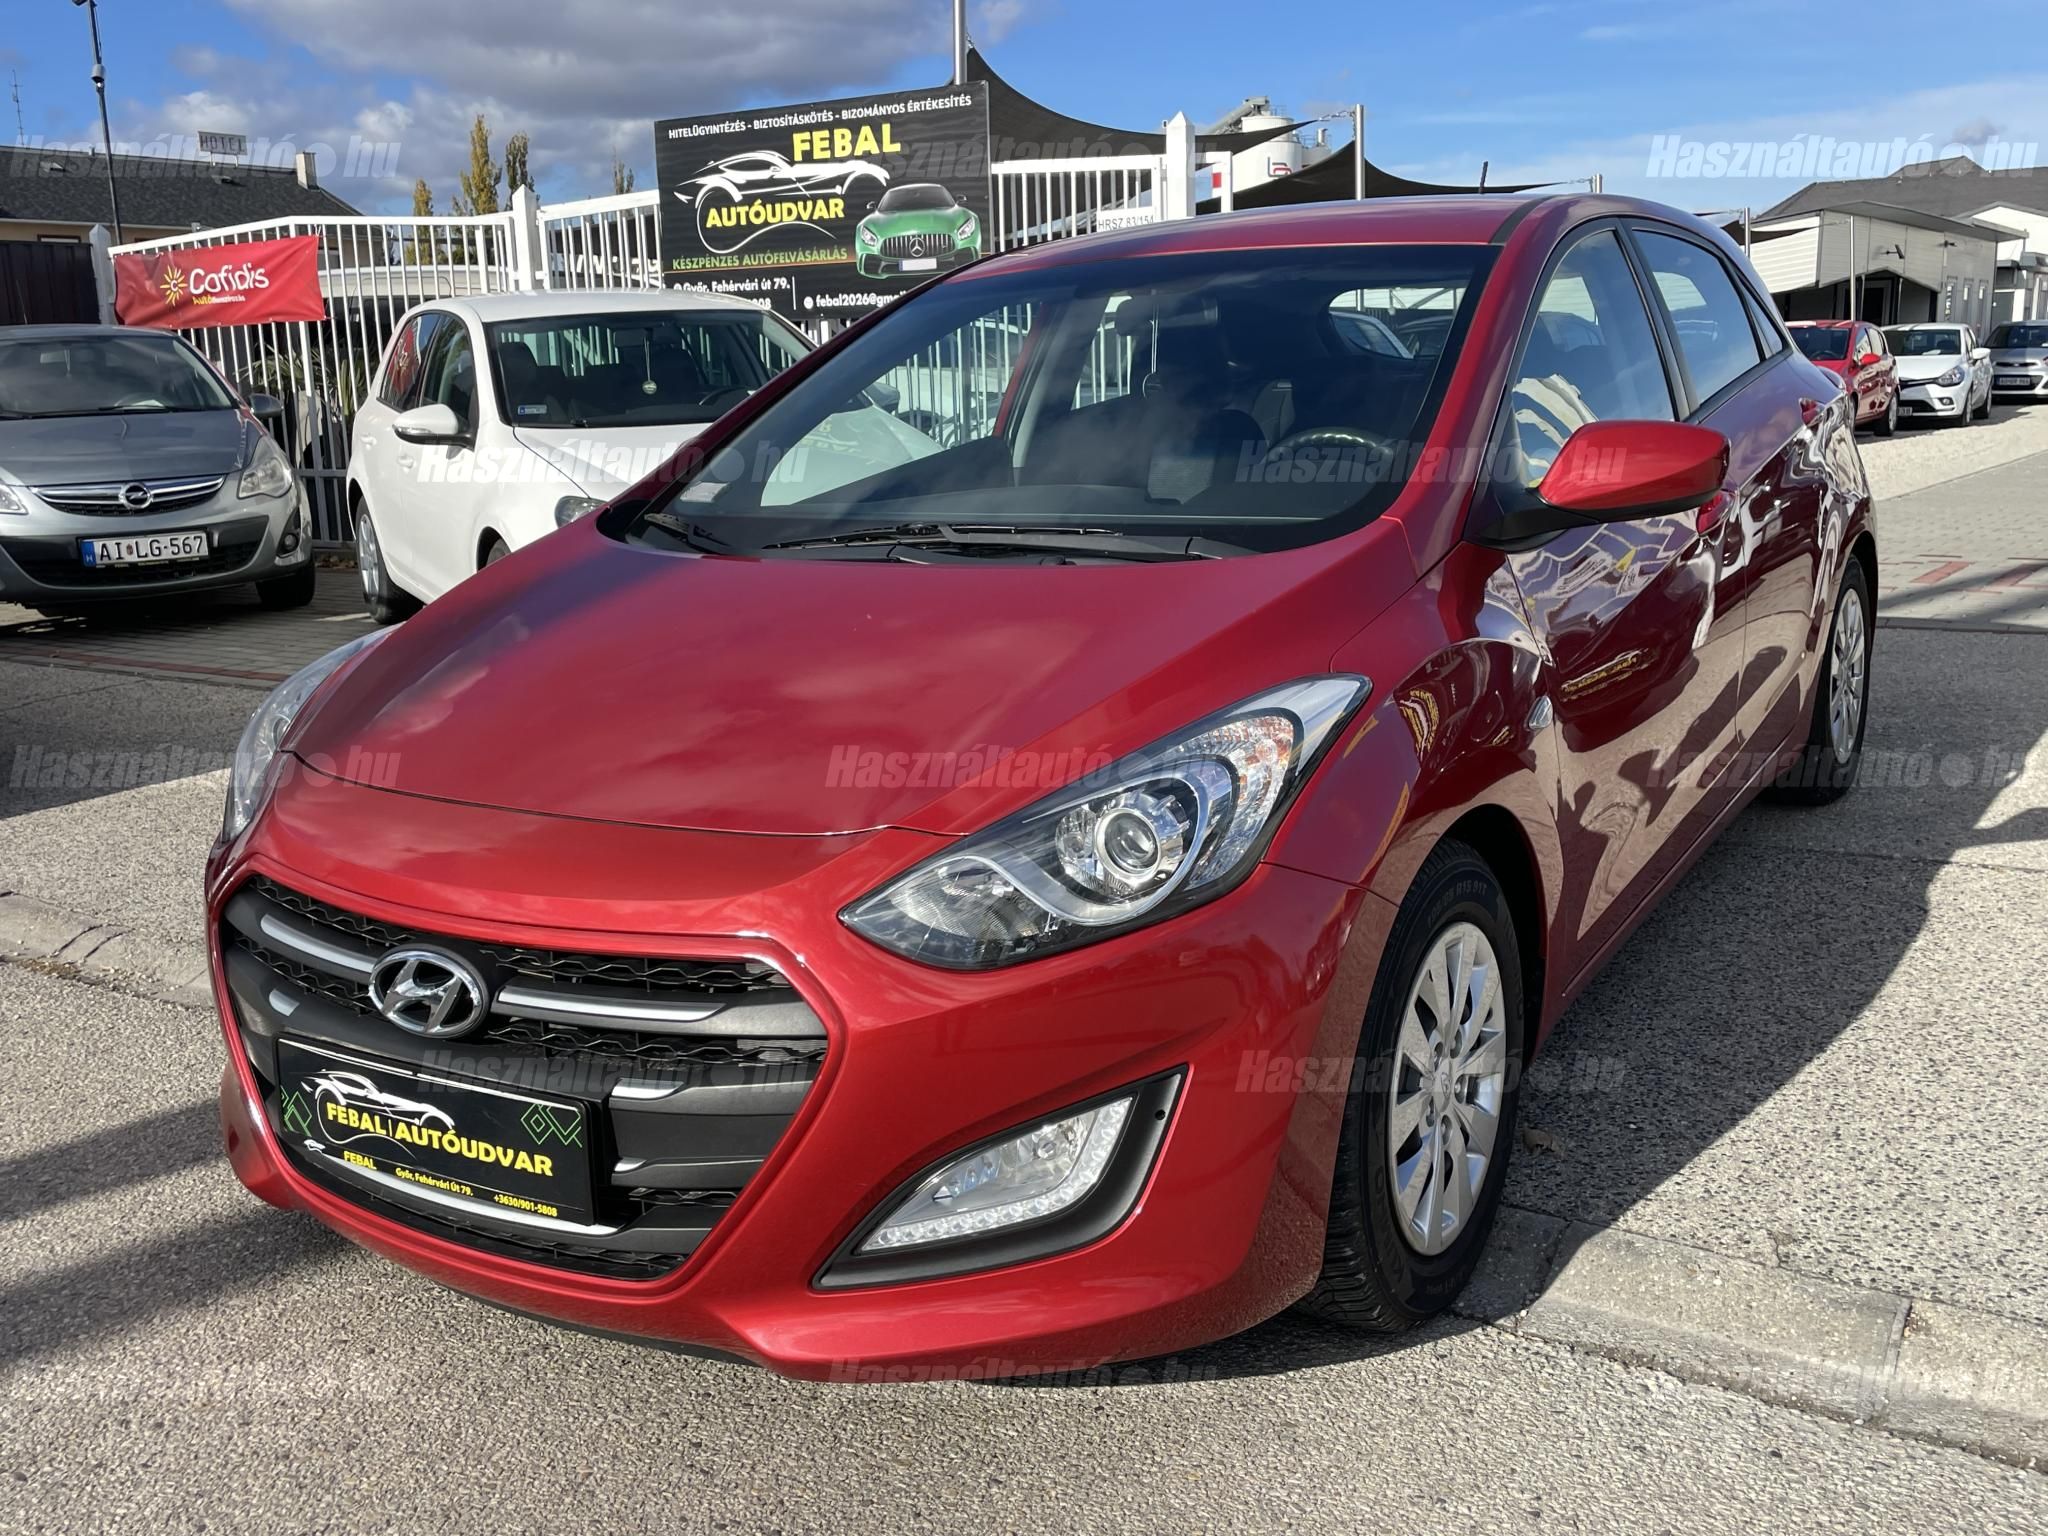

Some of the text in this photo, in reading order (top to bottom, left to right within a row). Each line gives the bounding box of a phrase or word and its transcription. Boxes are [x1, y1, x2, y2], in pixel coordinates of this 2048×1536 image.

[841, 103, 906, 120] BIZOMÁNYOS
[907, 94, 972, 112] ÉRTÉKESÍTÉS
[200, 135, 245, 152] HOTEL
[792, 123, 901, 161] FEBAL
[706, 199, 844, 228] AUTÓUDVAR
[1099, 217, 1123, 230] HRSZ
[672, 247, 848, 270] KÉSZPÉNZES AUTÓFELVÁSÁRLÁS
[189, 262, 270, 294] Cofidis
[761, 278, 771, 290] út
[773, 277, 790, 290] 79.
[100, 536, 203, 560] AI LG-567
[326, 1102, 553, 1177] FEBAL AUTÓUDVAR
[343, 1150, 377, 1170] FEBAL
[494, 1194, 558, 1217] +3630/901-5808
